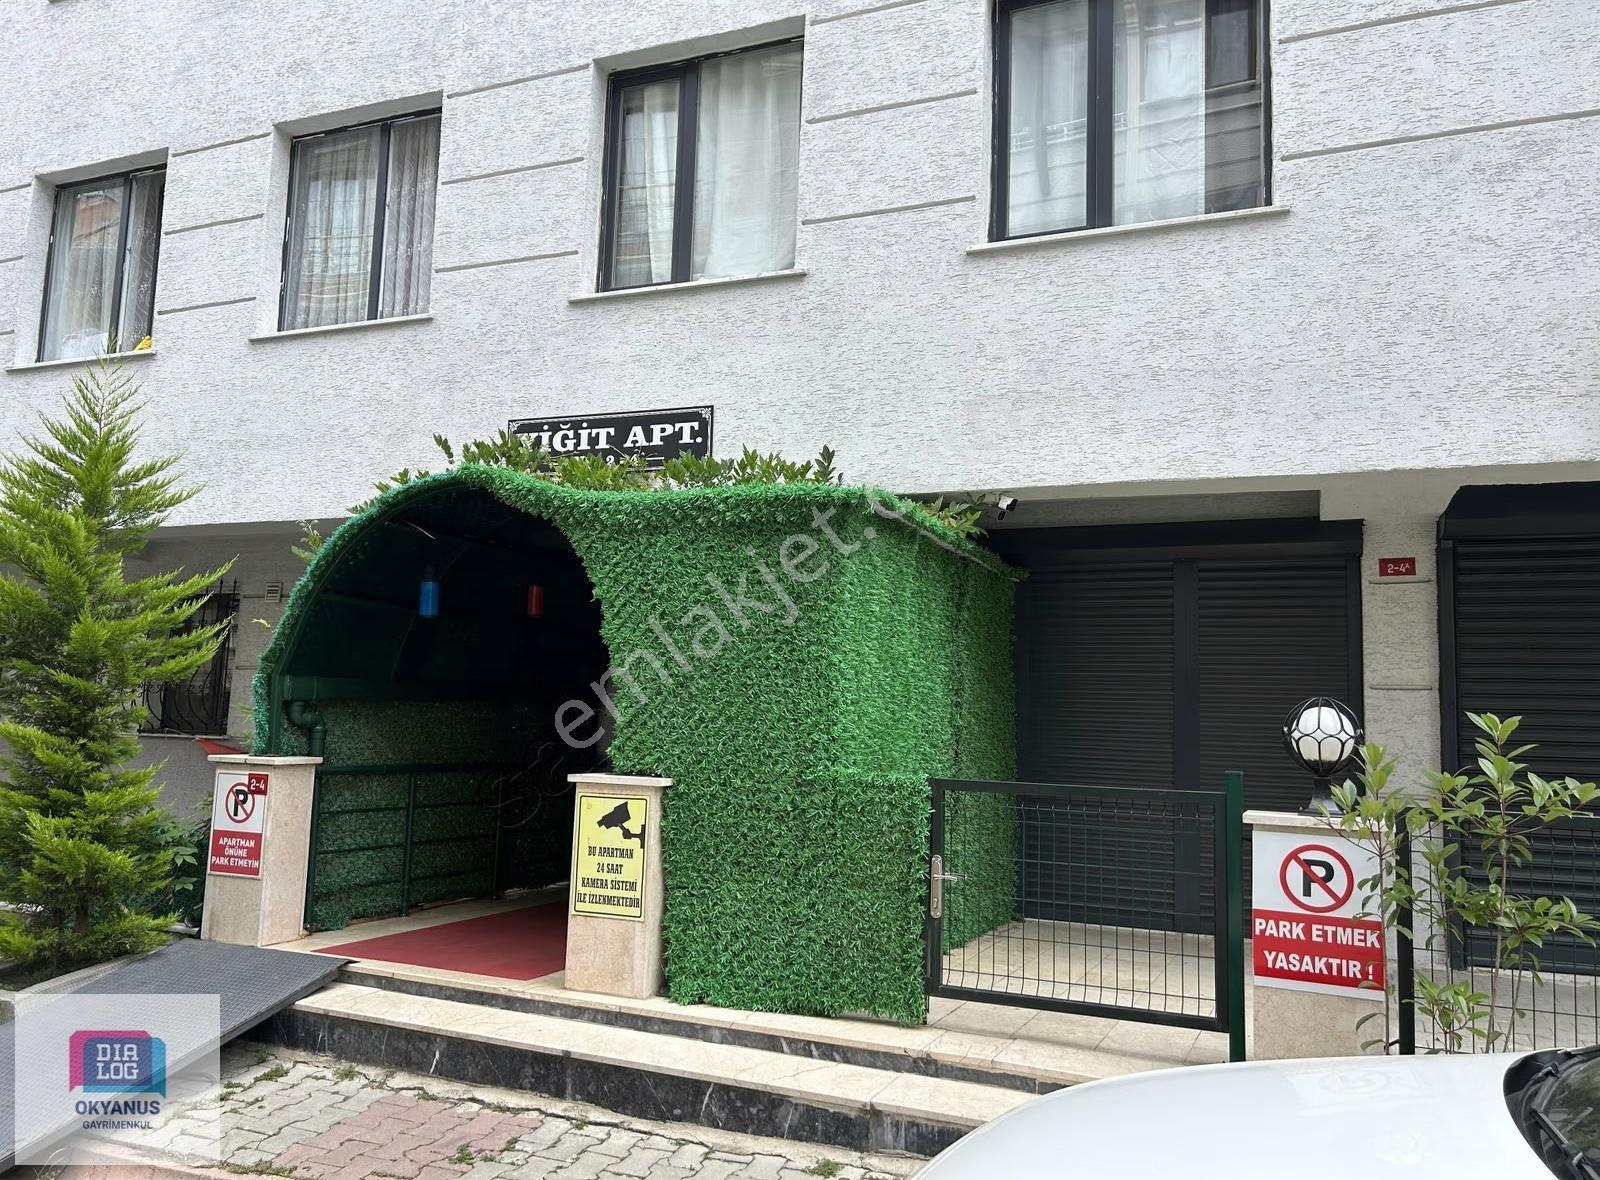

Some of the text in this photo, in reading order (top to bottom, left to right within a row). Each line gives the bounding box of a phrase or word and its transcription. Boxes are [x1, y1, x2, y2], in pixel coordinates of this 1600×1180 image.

[623, 421, 703, 448] APT.
[250, 779, 265, 791] 2-4
[219, 837, 255, 848] APARTMAN
[224, 845, 248, 857] ÖNÜNE
[588, 846, 634, 859] BU APARTMAN
[211, 855, 259, 869] PARK ETMEYİN
[596, 862, 624, 875] 24 SAAT
[581, 877, 637, 892] KAMERA SİSTEMİ
[576, 890, 640, 908] İLE İZLENMEKTEDİR
[1255, 918, 1381, 948] PARK ETMEK
[1263, 950, 1362, 979] YASAKTIR
